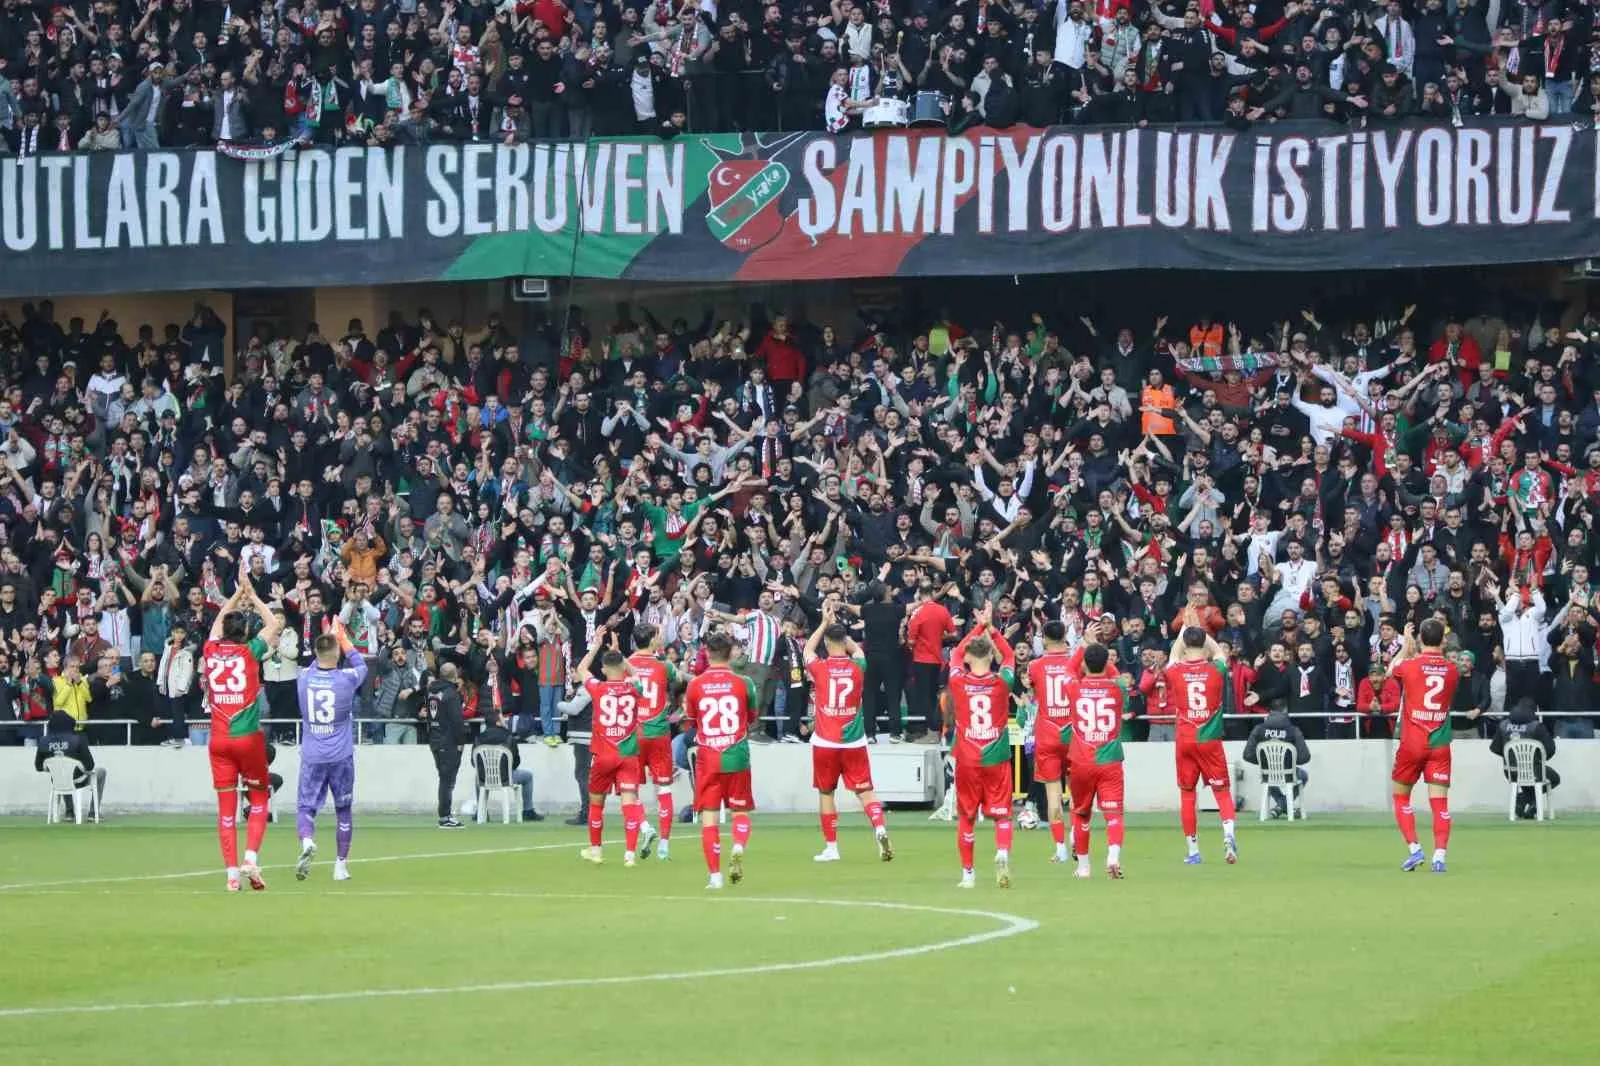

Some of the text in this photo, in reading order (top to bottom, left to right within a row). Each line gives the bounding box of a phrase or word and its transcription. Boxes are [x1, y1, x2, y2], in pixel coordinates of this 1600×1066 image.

[0, 151, 226, 251] UTLARA
[207, 657, 247, 692] 23
[1046, 674, 1071, 706] 10
[307, 688, 336, 723] 13
[600, 694, 635, 726] 93
[829, 678, 854, 708] 17
[1187, 682, 1208, 710] 6
[1423, 676, 1445, 710] 2
[699, 695, 739, 735] 28
[969, 694, 992, 729] 8
[1076, 697, 1116, 732] 95
